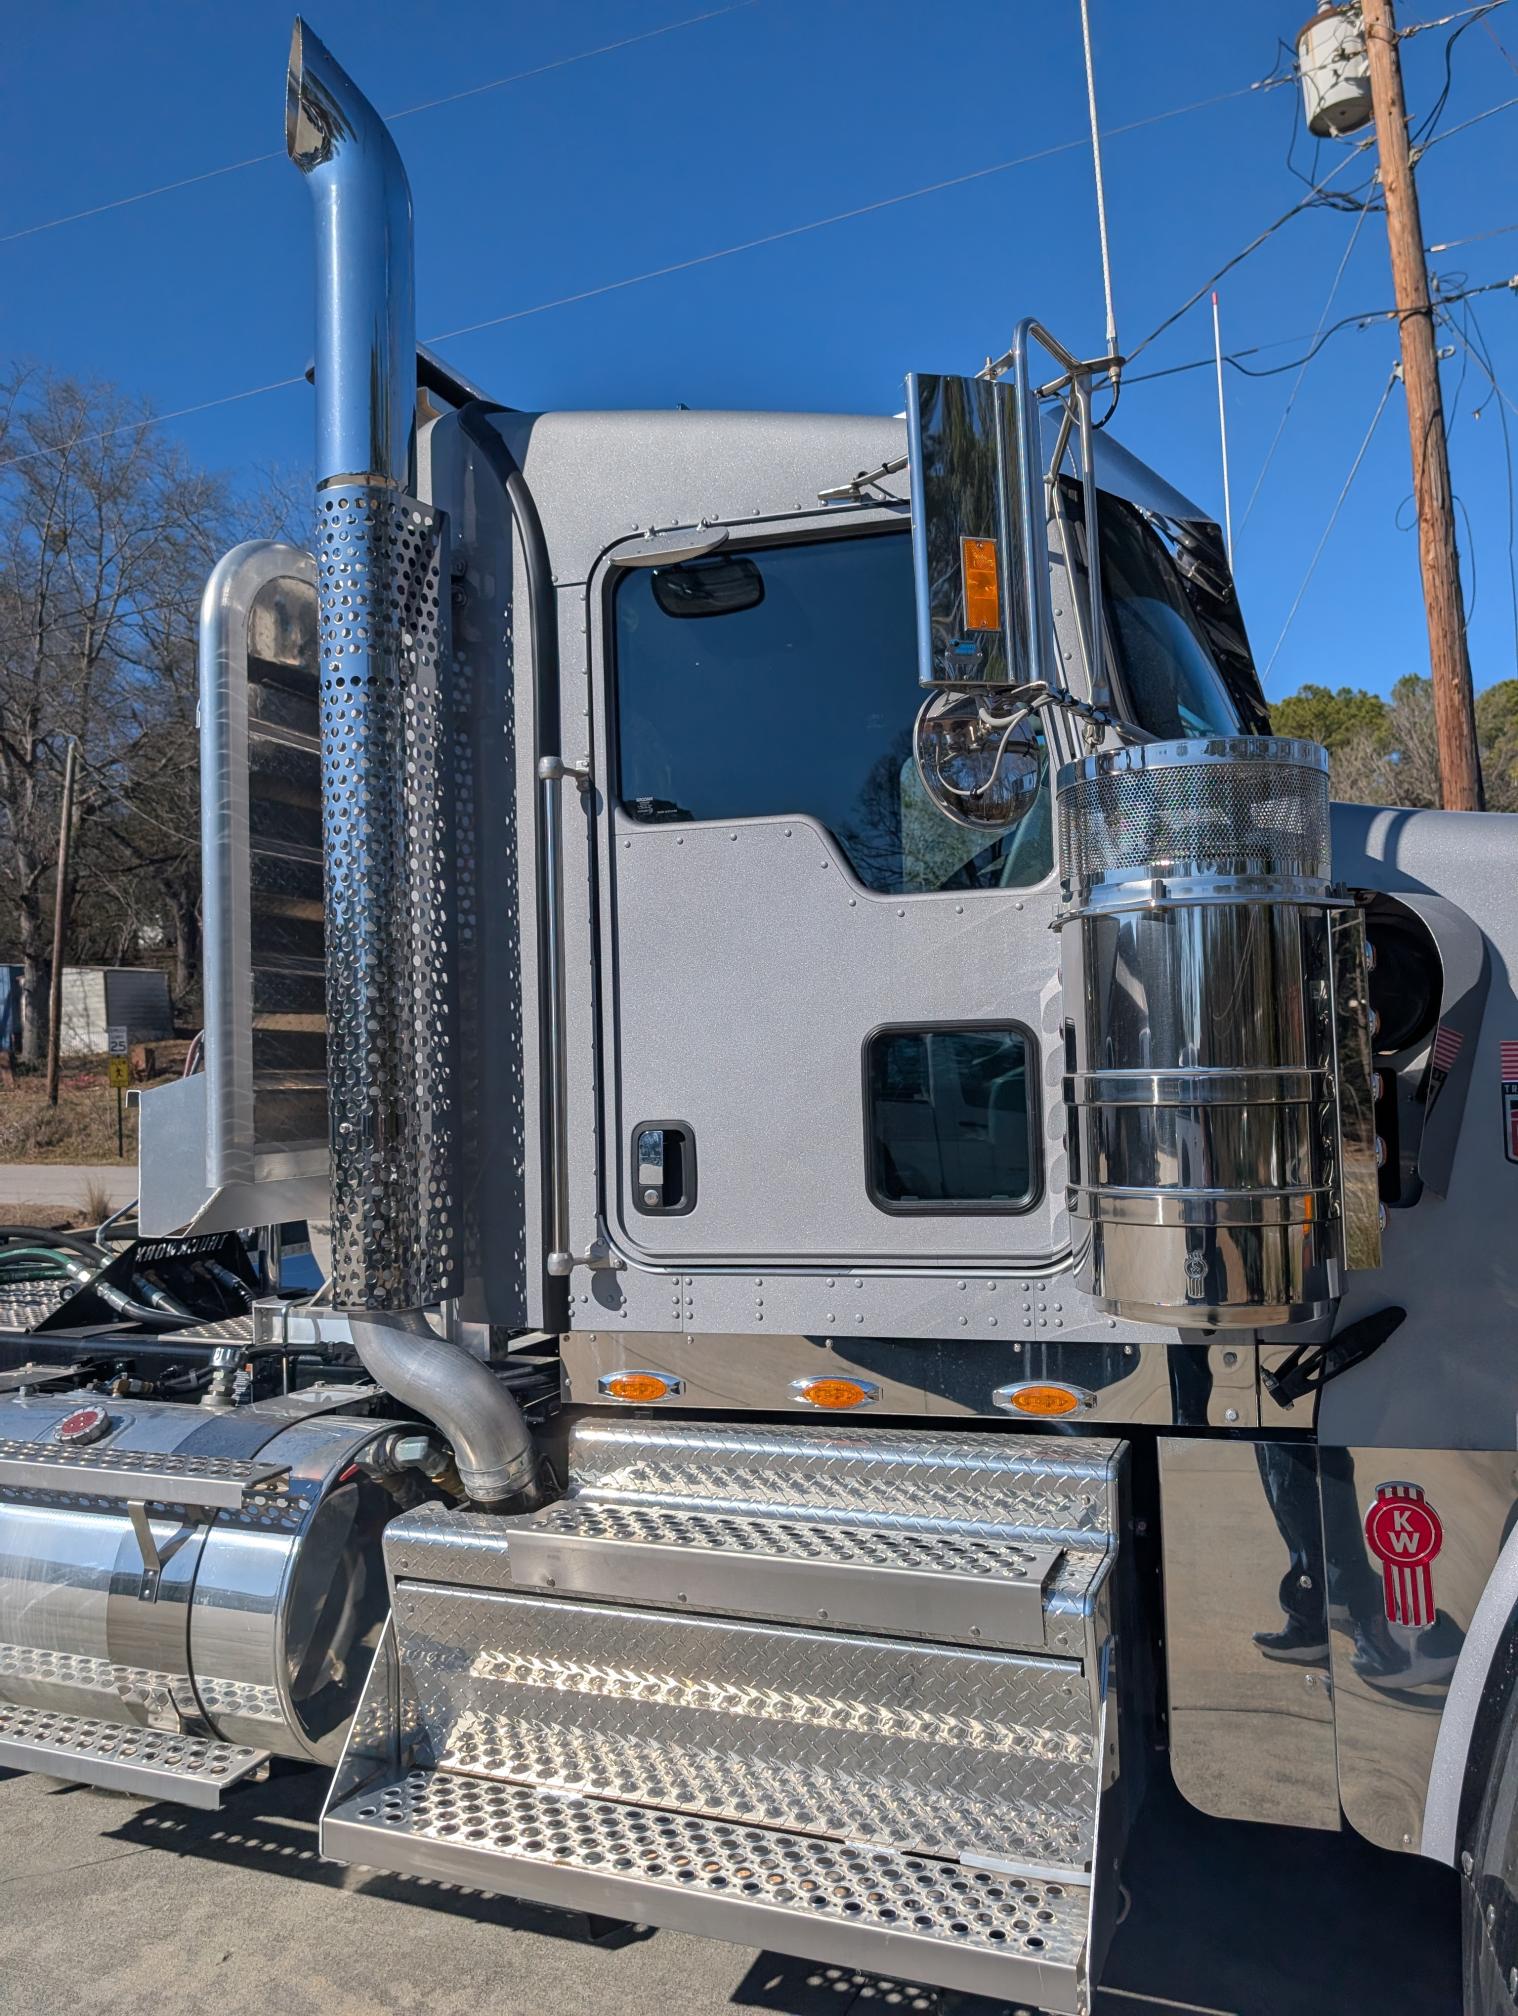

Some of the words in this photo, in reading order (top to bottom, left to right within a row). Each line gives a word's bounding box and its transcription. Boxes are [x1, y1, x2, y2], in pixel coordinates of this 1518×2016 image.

[111, 1040, 127, 1052] 25
[1393, 1510, 1414, 1531] K
[1388, 1531, 1420, 1553] W
